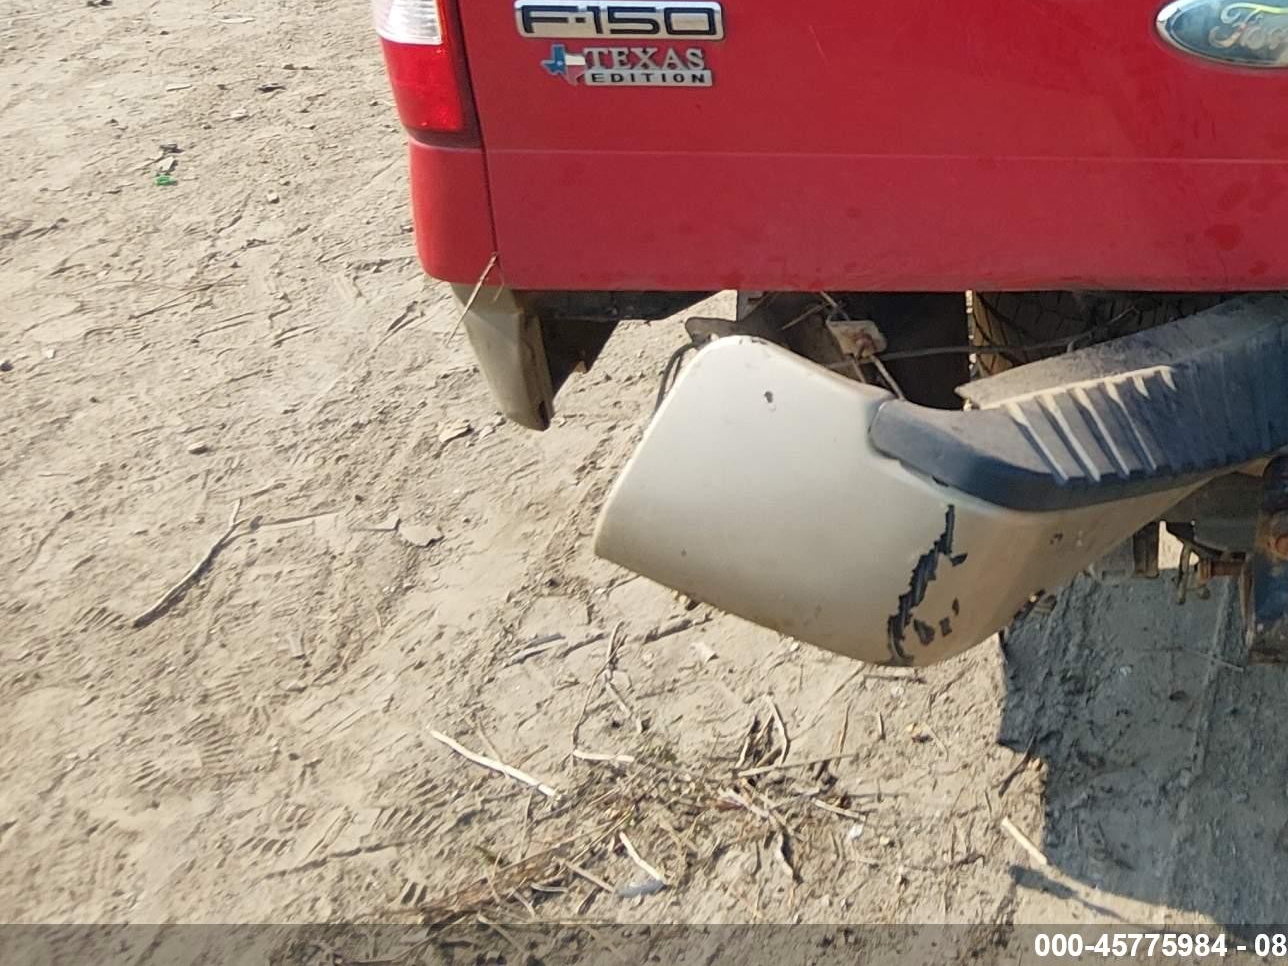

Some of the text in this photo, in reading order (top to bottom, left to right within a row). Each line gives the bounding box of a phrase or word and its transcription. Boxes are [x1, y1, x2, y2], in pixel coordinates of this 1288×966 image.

[520, 4, 718, 35] F-150
[583, 47, 705, 71] TEXAS
[590, 72, 706, 84] EDITION
